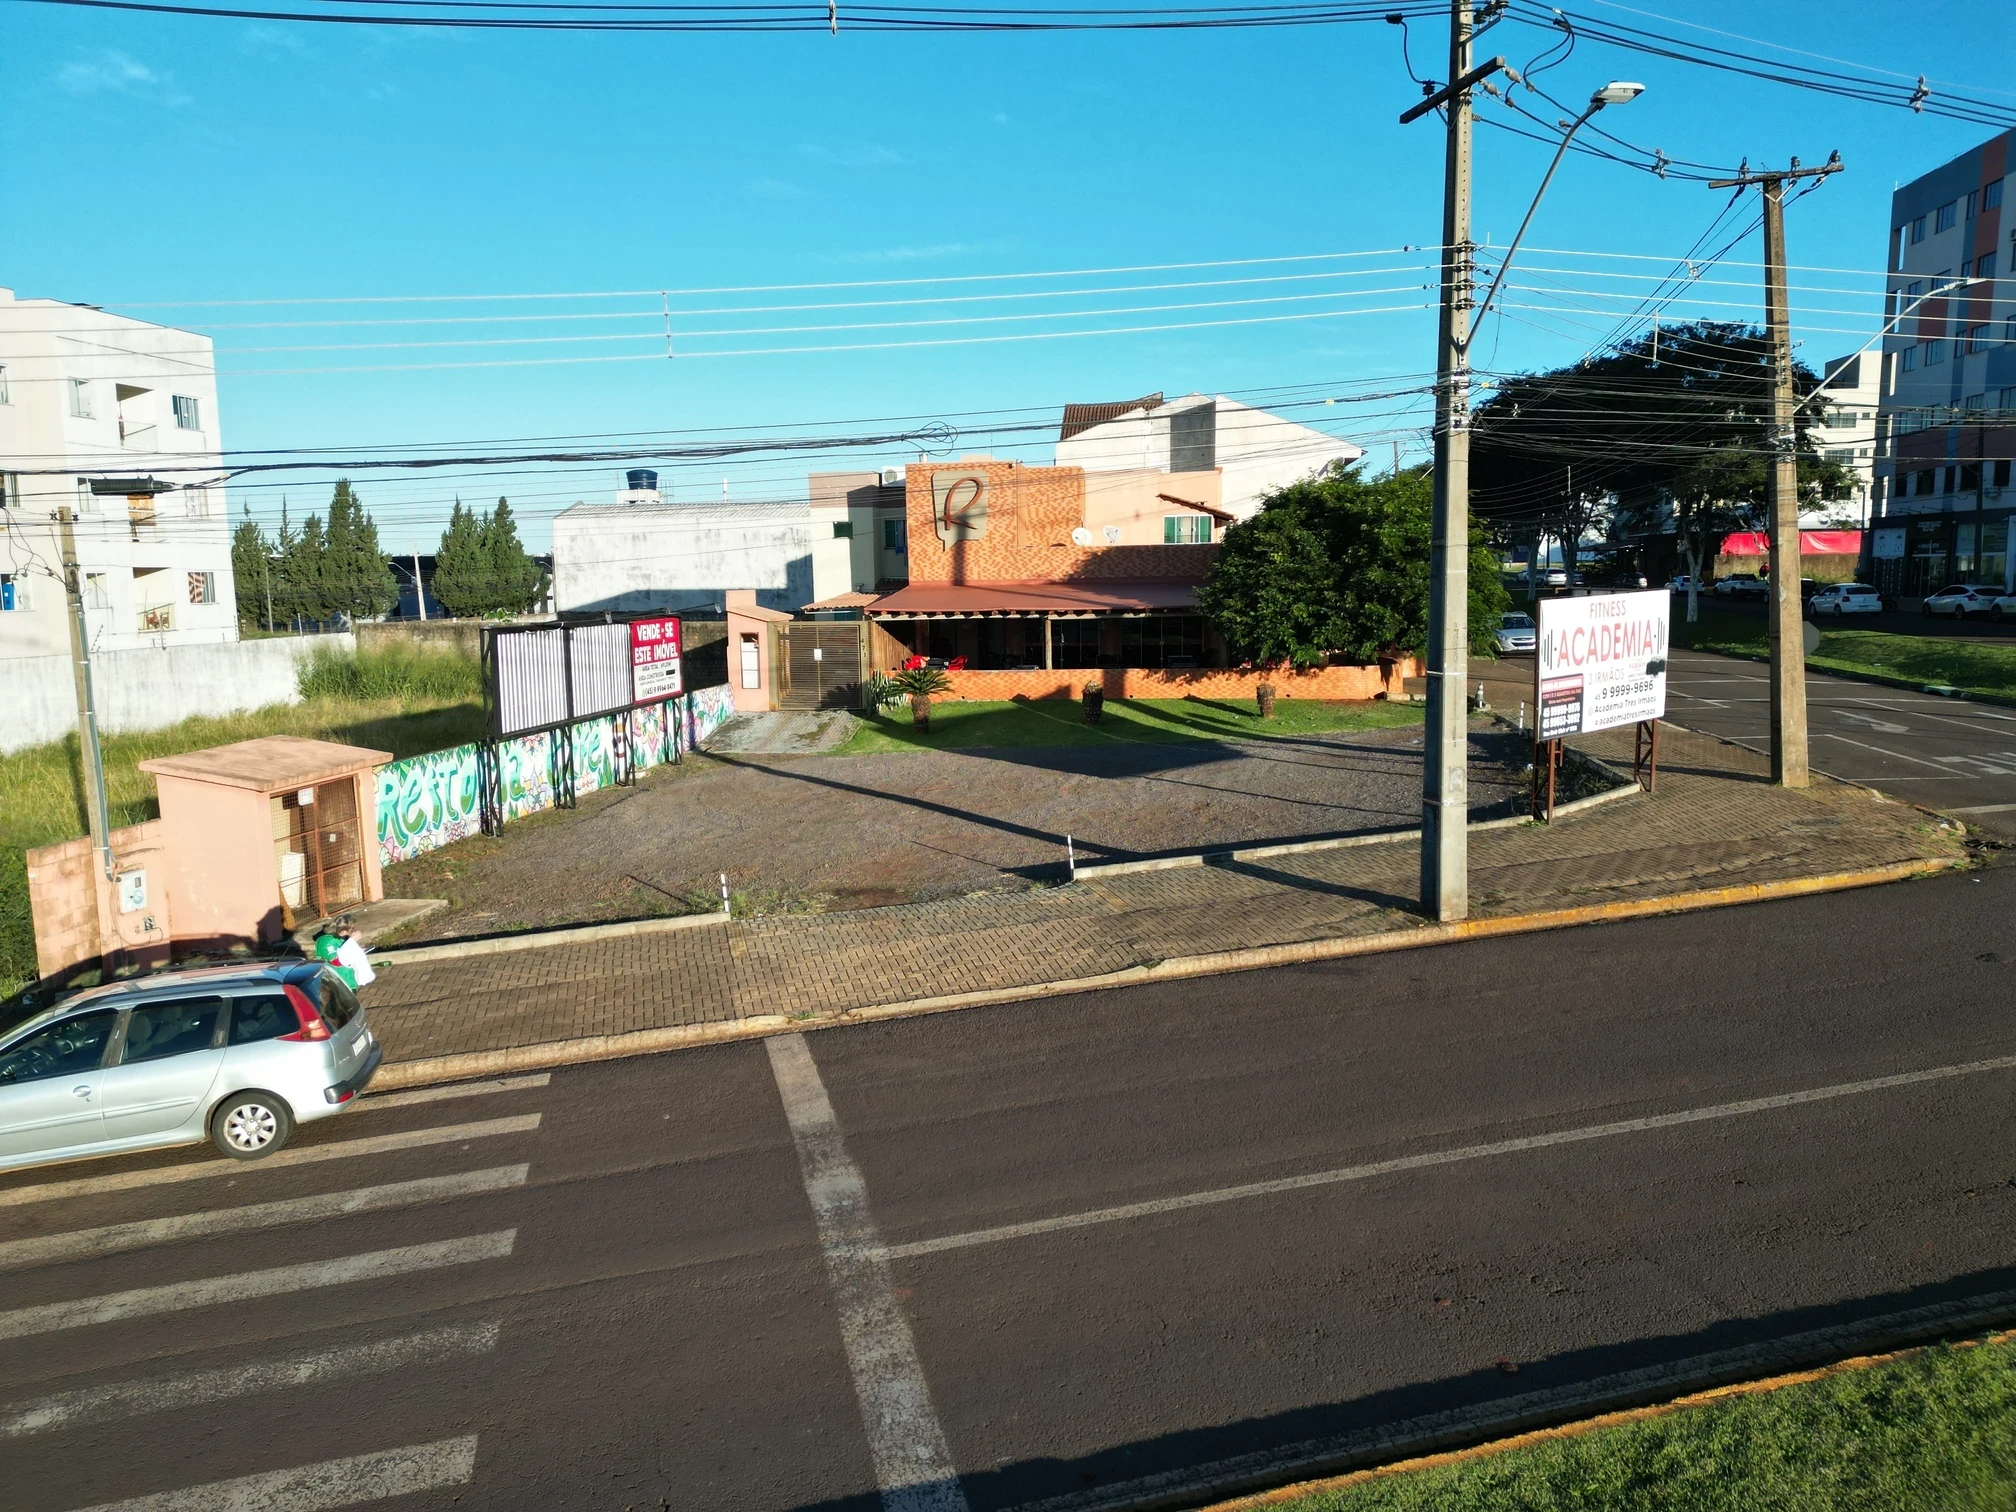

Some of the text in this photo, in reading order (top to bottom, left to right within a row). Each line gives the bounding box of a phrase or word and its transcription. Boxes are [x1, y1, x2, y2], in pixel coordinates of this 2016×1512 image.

[1589, 600, 1626, 619] FITNESS
[634, 638, 678, 664] ESTE IMÓVEL
[1557, 619, 1653, 669] ACADEMIA
[1588, 673, 1593, 686] 3
[1595, 666, 1625, 685] IRMÃOS
[1602, 687, 1608, 699] 9
[1609, 680, 1654, 698] 9999-9696
[1594, 701, 1623, 714] Academia
[1625, 699, 1636, 708] Tres
